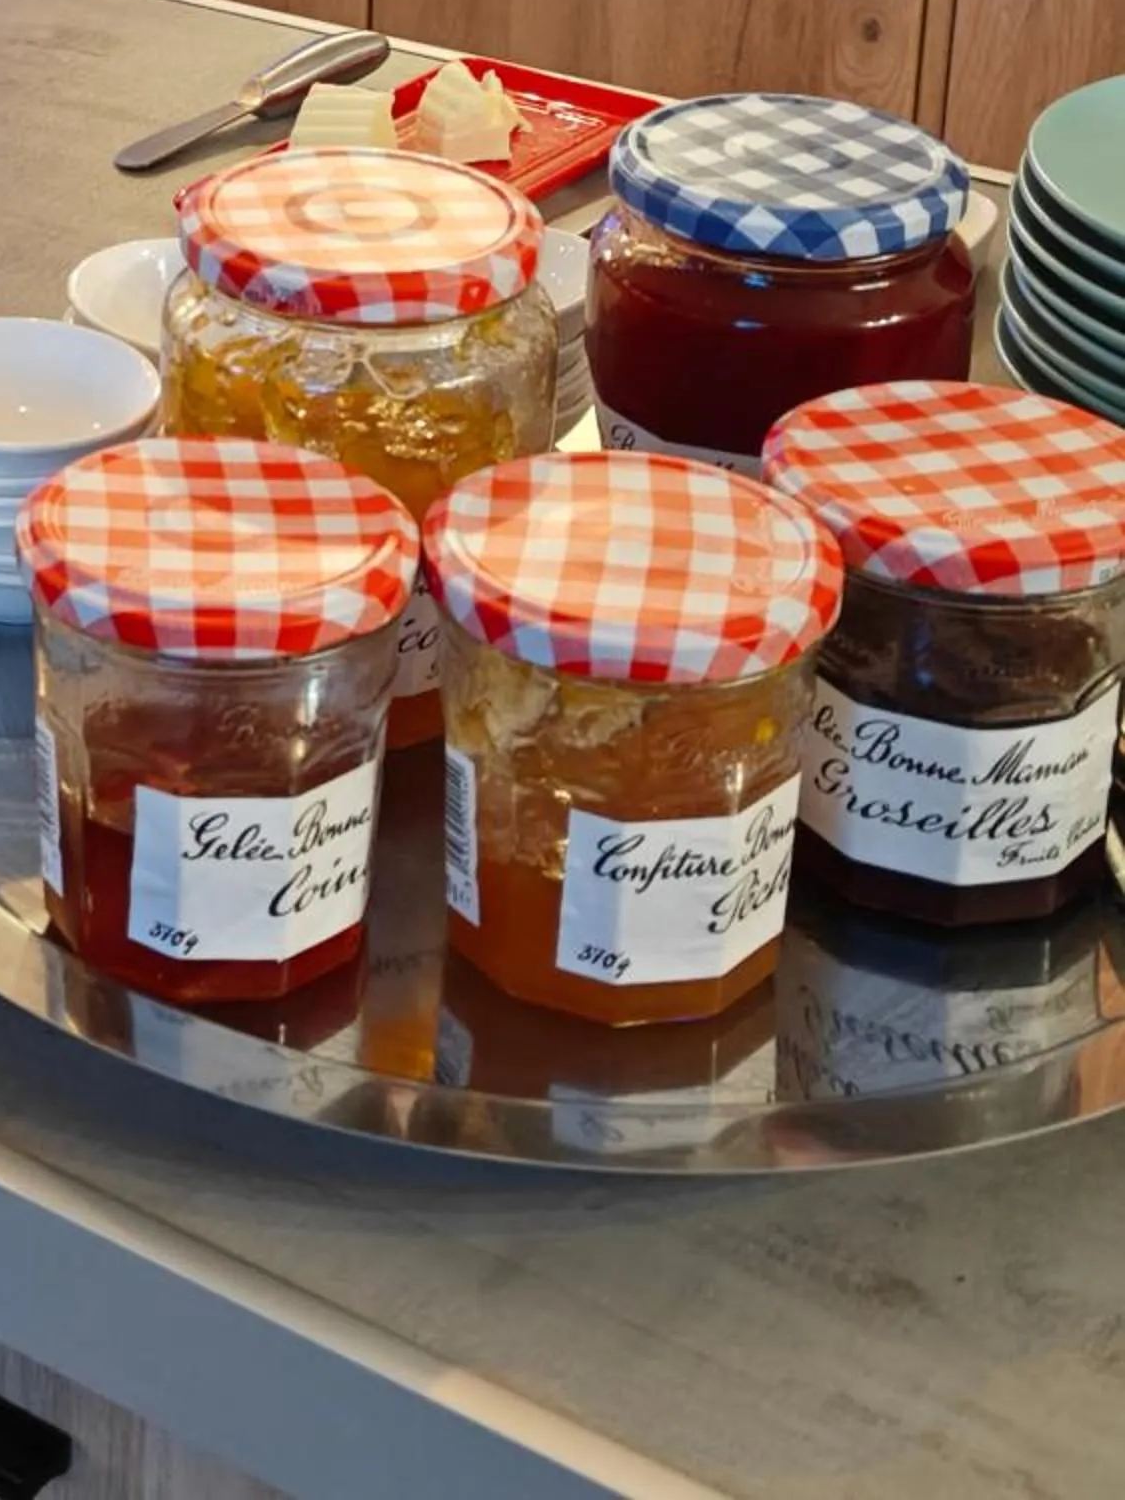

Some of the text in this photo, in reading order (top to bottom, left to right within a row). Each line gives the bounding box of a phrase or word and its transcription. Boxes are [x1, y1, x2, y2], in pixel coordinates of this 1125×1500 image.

[813, 705, 1089, 785] lée Bonne Maman
[181, 797, 371, 861] Gelée Bonne
[813, 758, 1058, 842] Groseilles
[268, 857, 368, 918] Coin
[592, 833, 739, 895] Confiture
[707, 850, 791, 936] Pêch
